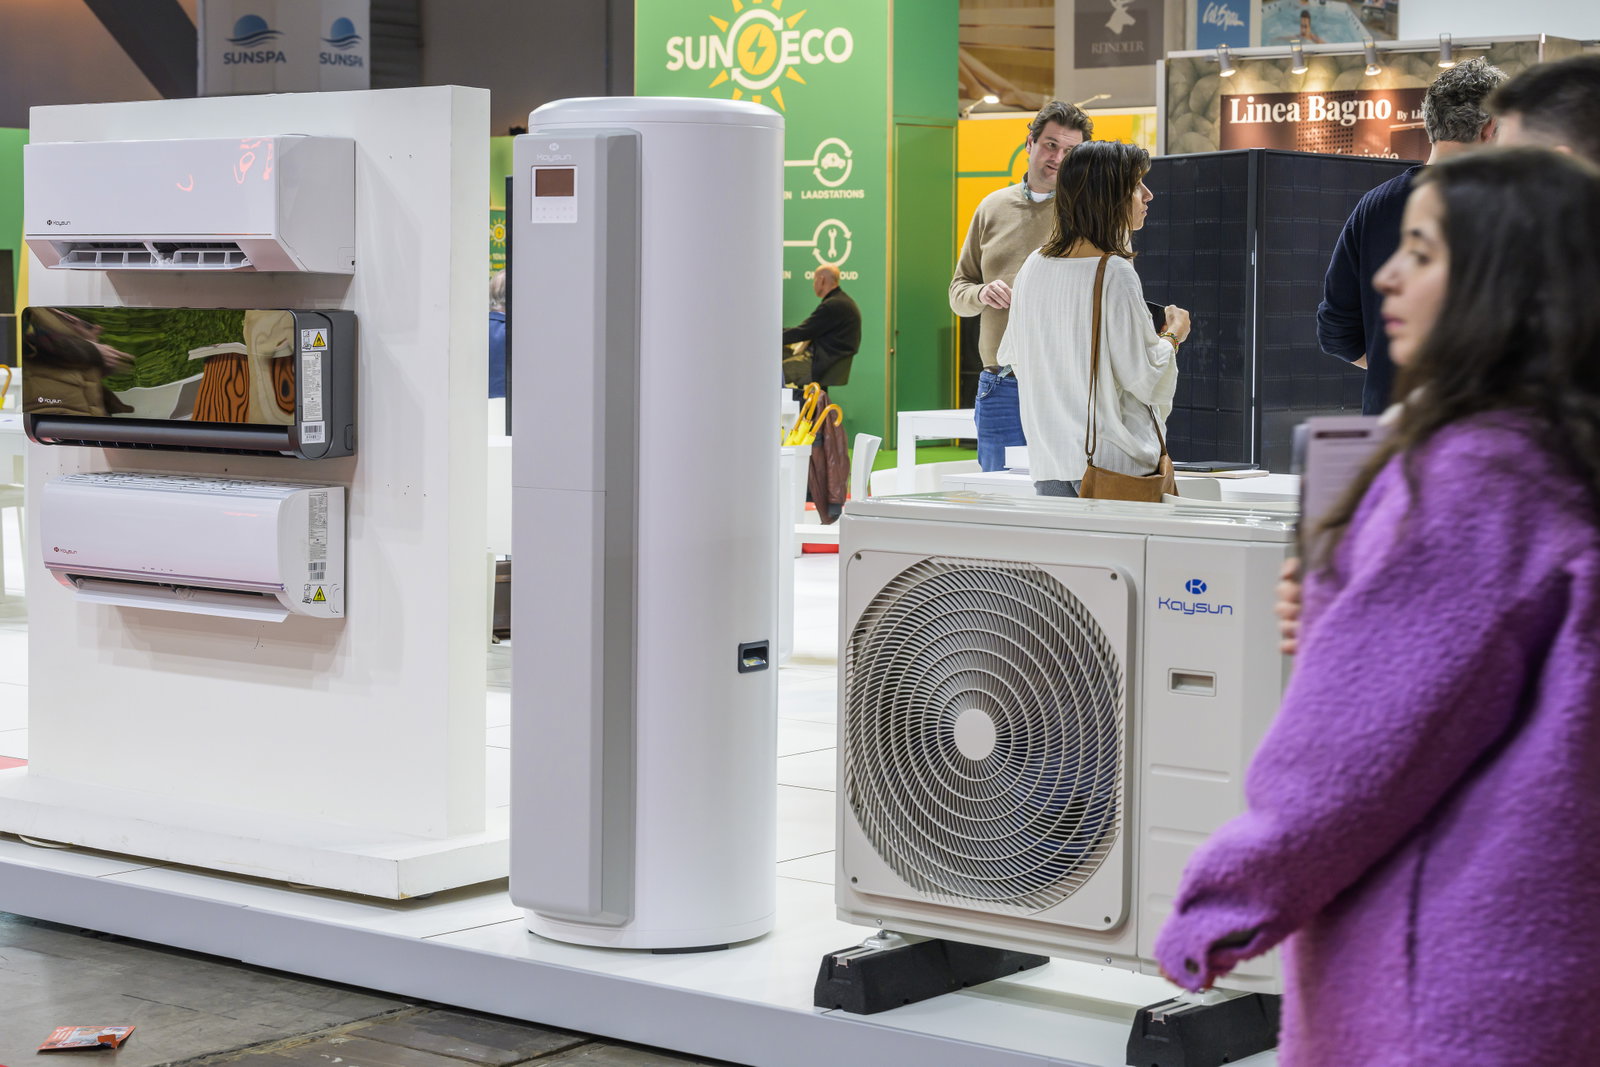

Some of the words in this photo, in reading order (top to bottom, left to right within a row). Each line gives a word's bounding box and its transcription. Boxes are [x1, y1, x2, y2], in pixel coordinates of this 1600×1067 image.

[223, 51, 287, 66] SUNSPA
[665, 35, 735, 72] SUN
[780, 27, 854, 65] ECO
[1229, 95, 1302, 124] Linea
[1307, 95, 1392, 127] Bagno
[1396, 110, 1409, 122] By
[801, 189, 865, 200] LAADSTATIONS
[1158, 597, 1233, 616] Kaysun
